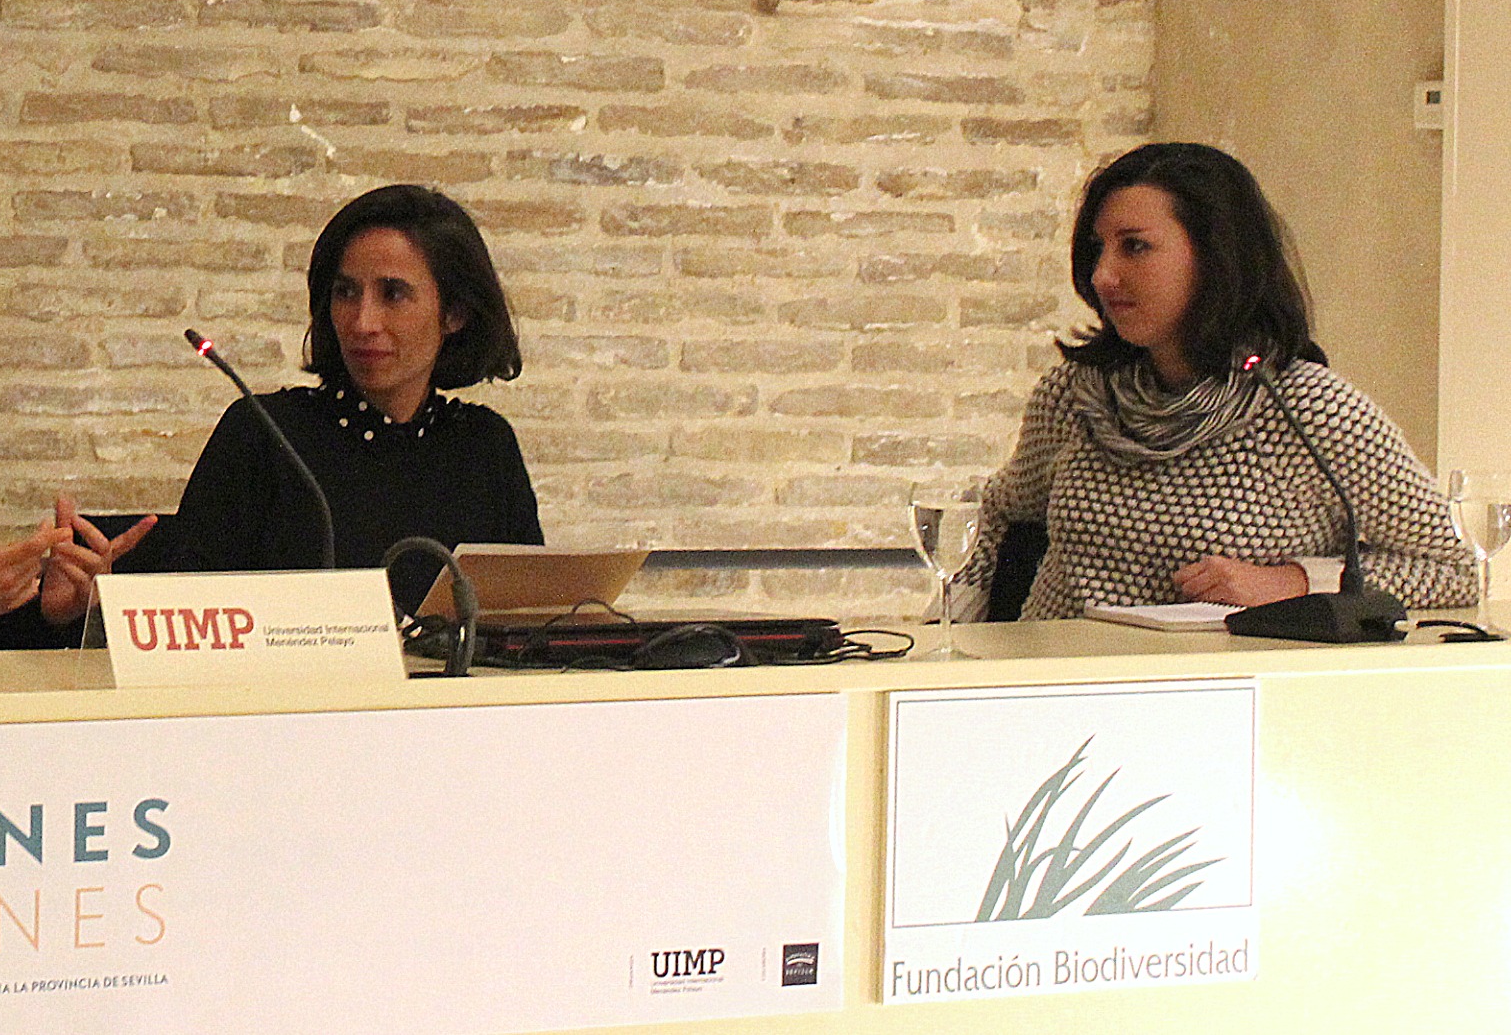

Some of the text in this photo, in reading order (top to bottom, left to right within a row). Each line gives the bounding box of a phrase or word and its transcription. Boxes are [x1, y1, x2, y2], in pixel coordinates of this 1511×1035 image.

[122, 607, 255, 652] UIMP
[651, 948, 726, 978] UIMP
[892, 938, 1249, 998] Fundación Biodiversidad
[13, 982, 29, 994] LA
[31, 977, 101, 992] PROVINCIA
[103, 976, 119, 988] DE
[121, 973, 169, 987] SEVILLA
